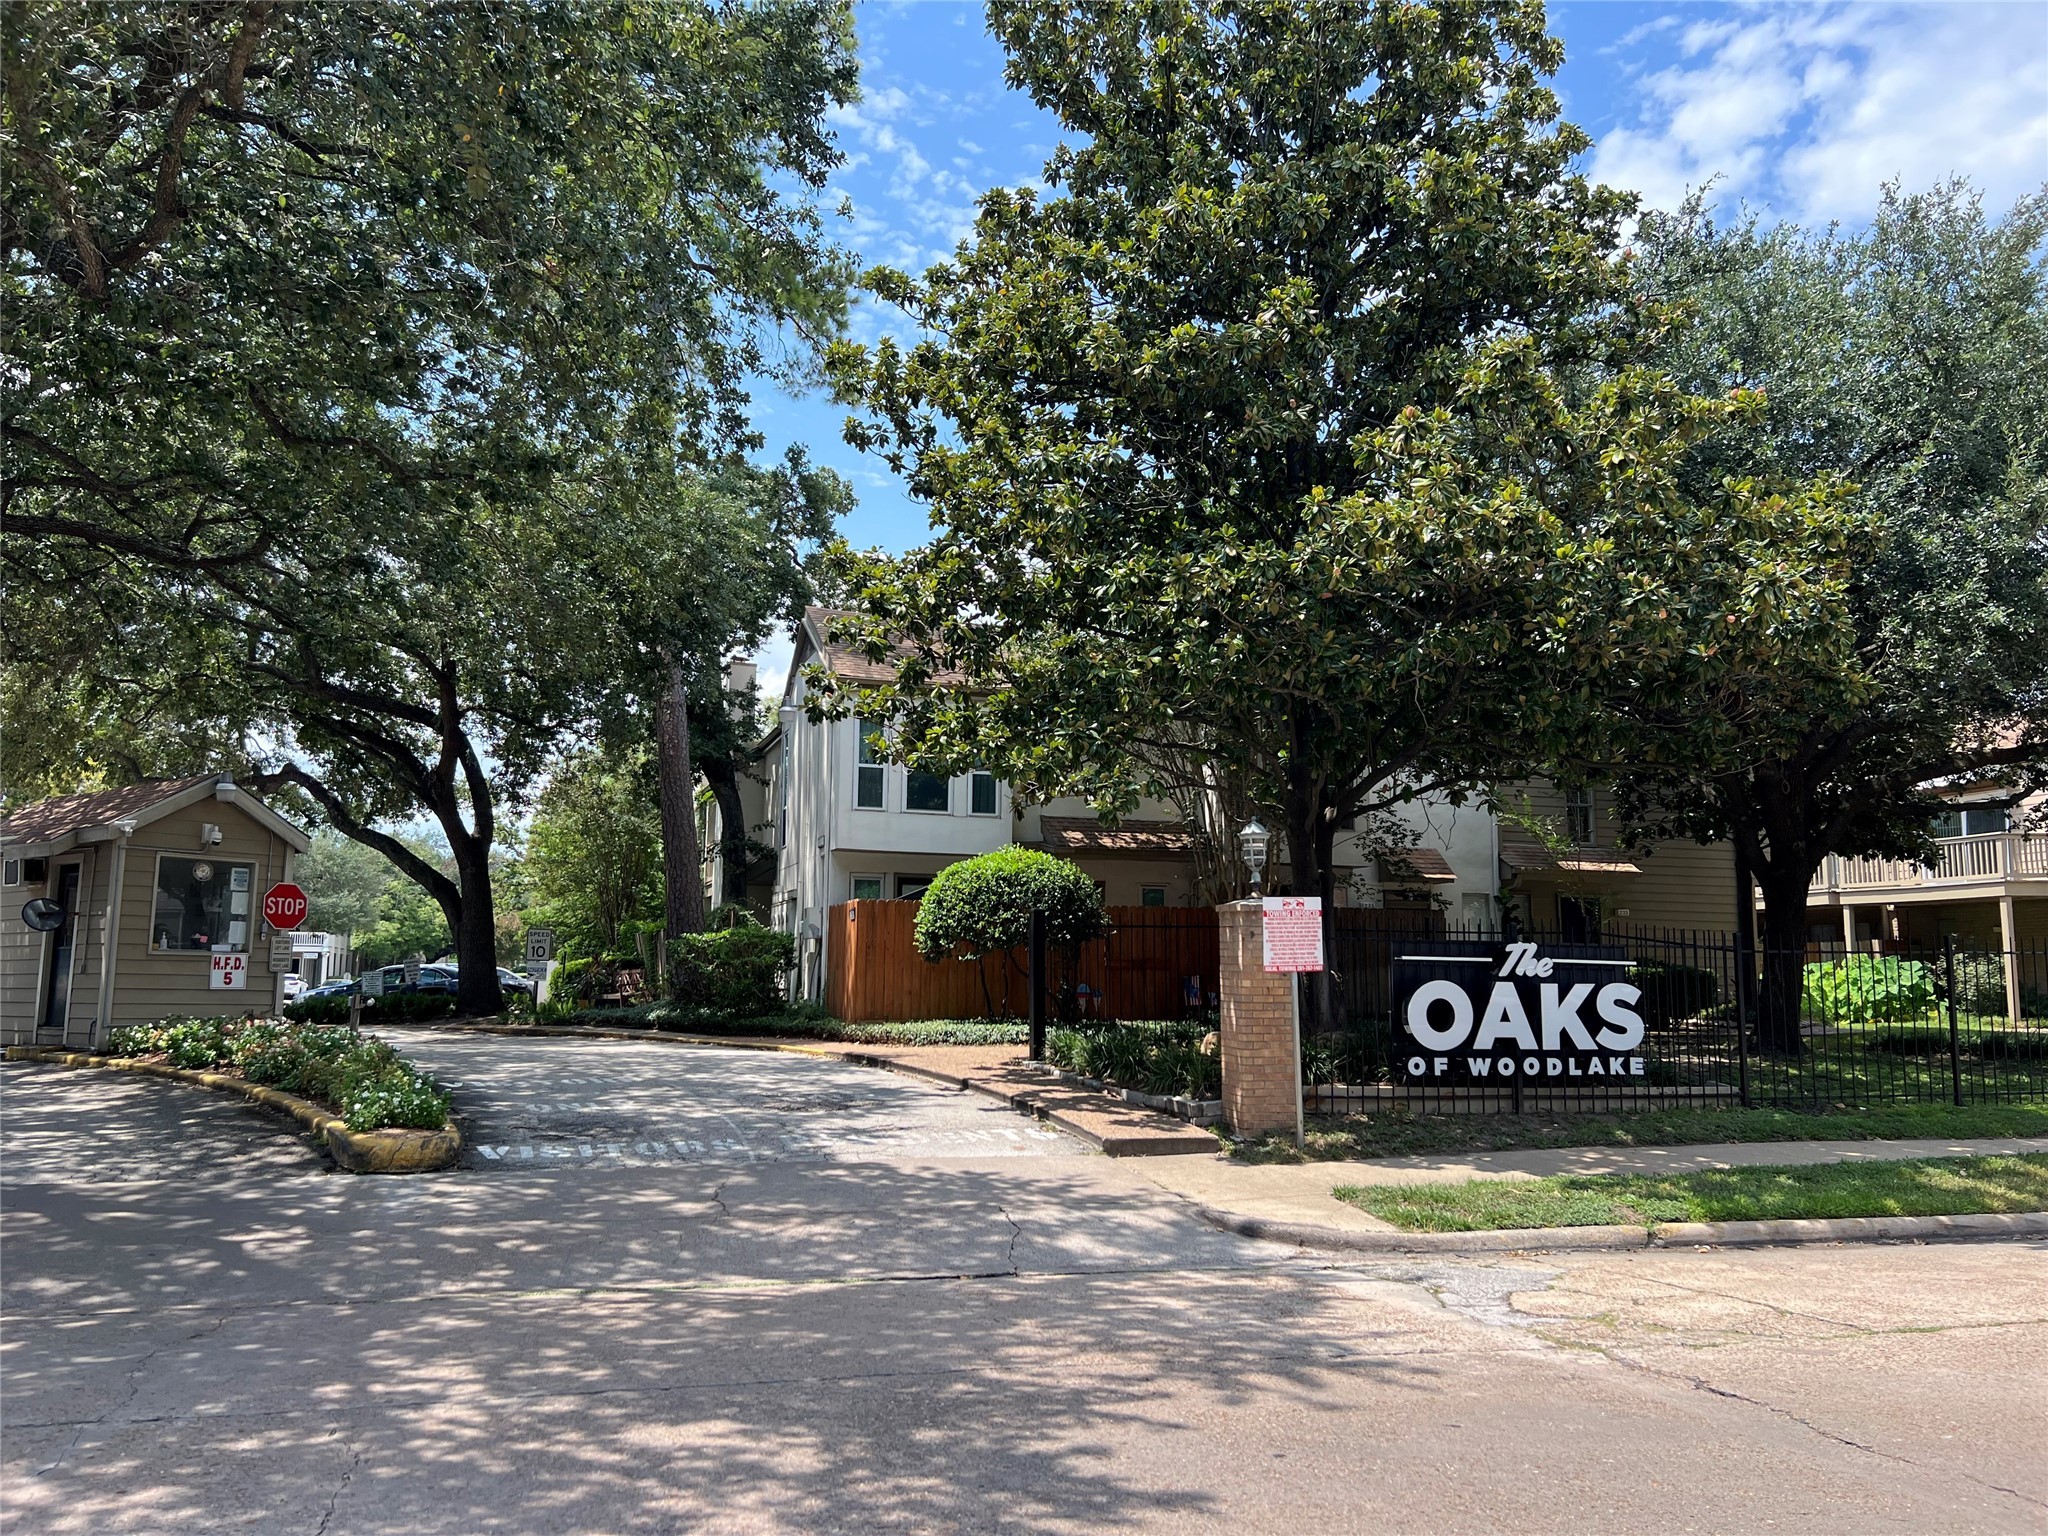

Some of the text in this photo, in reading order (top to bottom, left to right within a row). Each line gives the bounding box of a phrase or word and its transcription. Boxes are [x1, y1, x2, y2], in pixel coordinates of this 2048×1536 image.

[267, 896, 305, 915] STOP
[531, 945, 546, 958] 10
[1498, 941, 1554, 978] The
[213, 956, 245, 971] H.F.D.
[223, 972, 233, 986] 5
[1407, 979, 1645, 1051] OAKS
[1407, 1056, 1645, 1076] OF WOODLAKE
[475, 1138, 752, 1160] VISITORS
